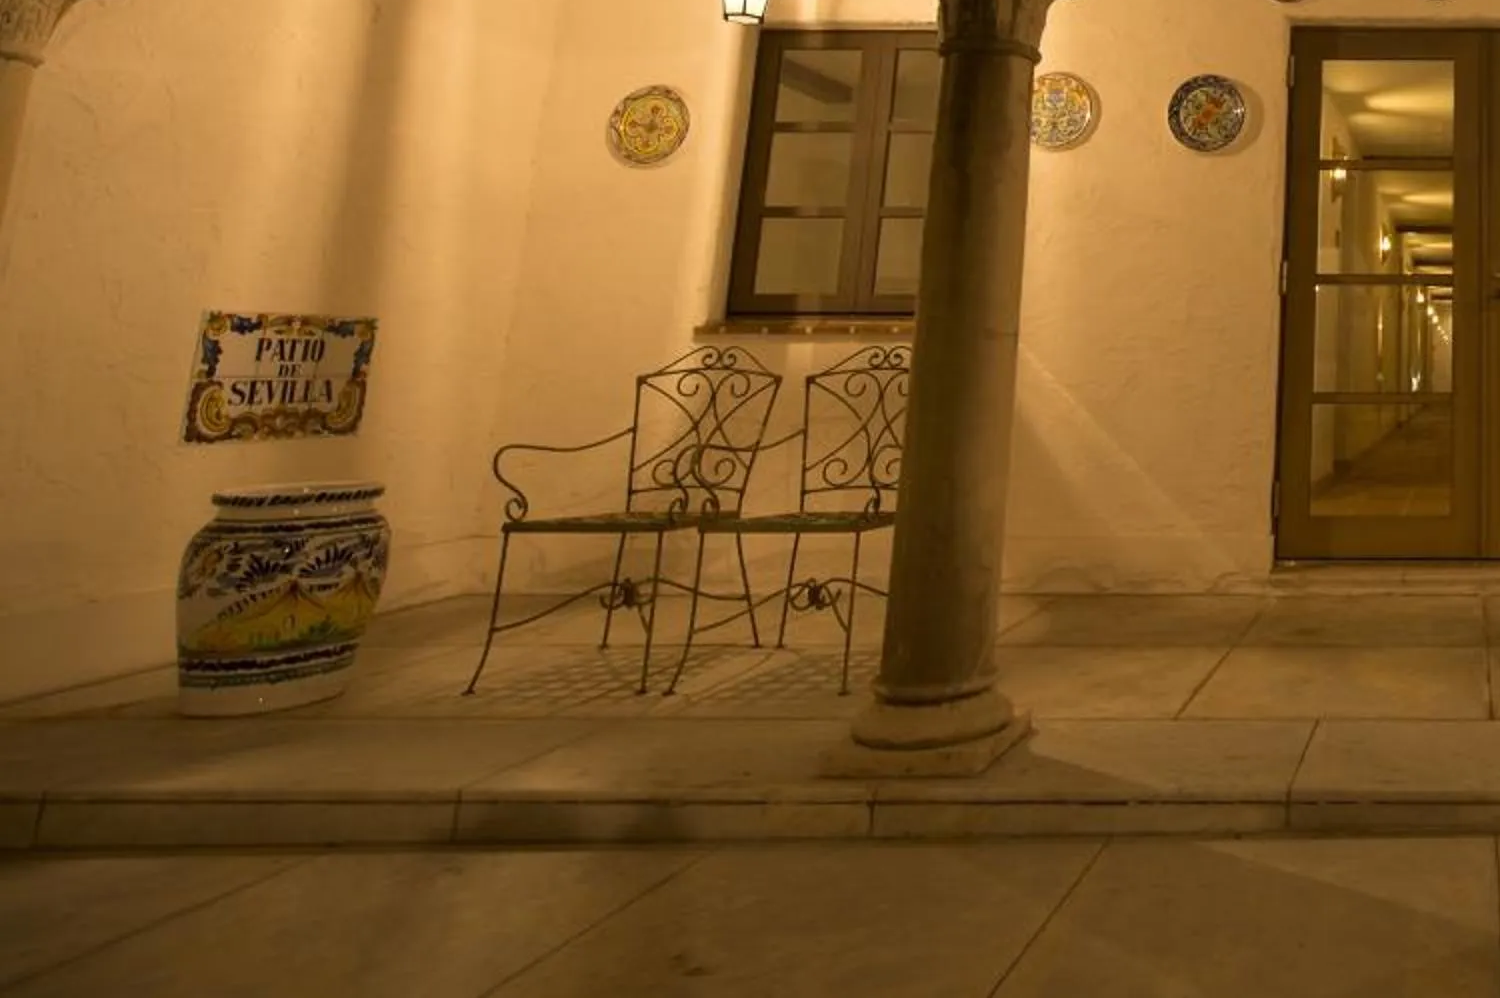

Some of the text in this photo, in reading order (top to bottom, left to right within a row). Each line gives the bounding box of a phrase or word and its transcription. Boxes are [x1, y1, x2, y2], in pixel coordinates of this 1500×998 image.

[255, 337, 325, 363] PATIO
[278, 364, 302, 378] DE
[228, 379, 333, 406] SEVILLA
